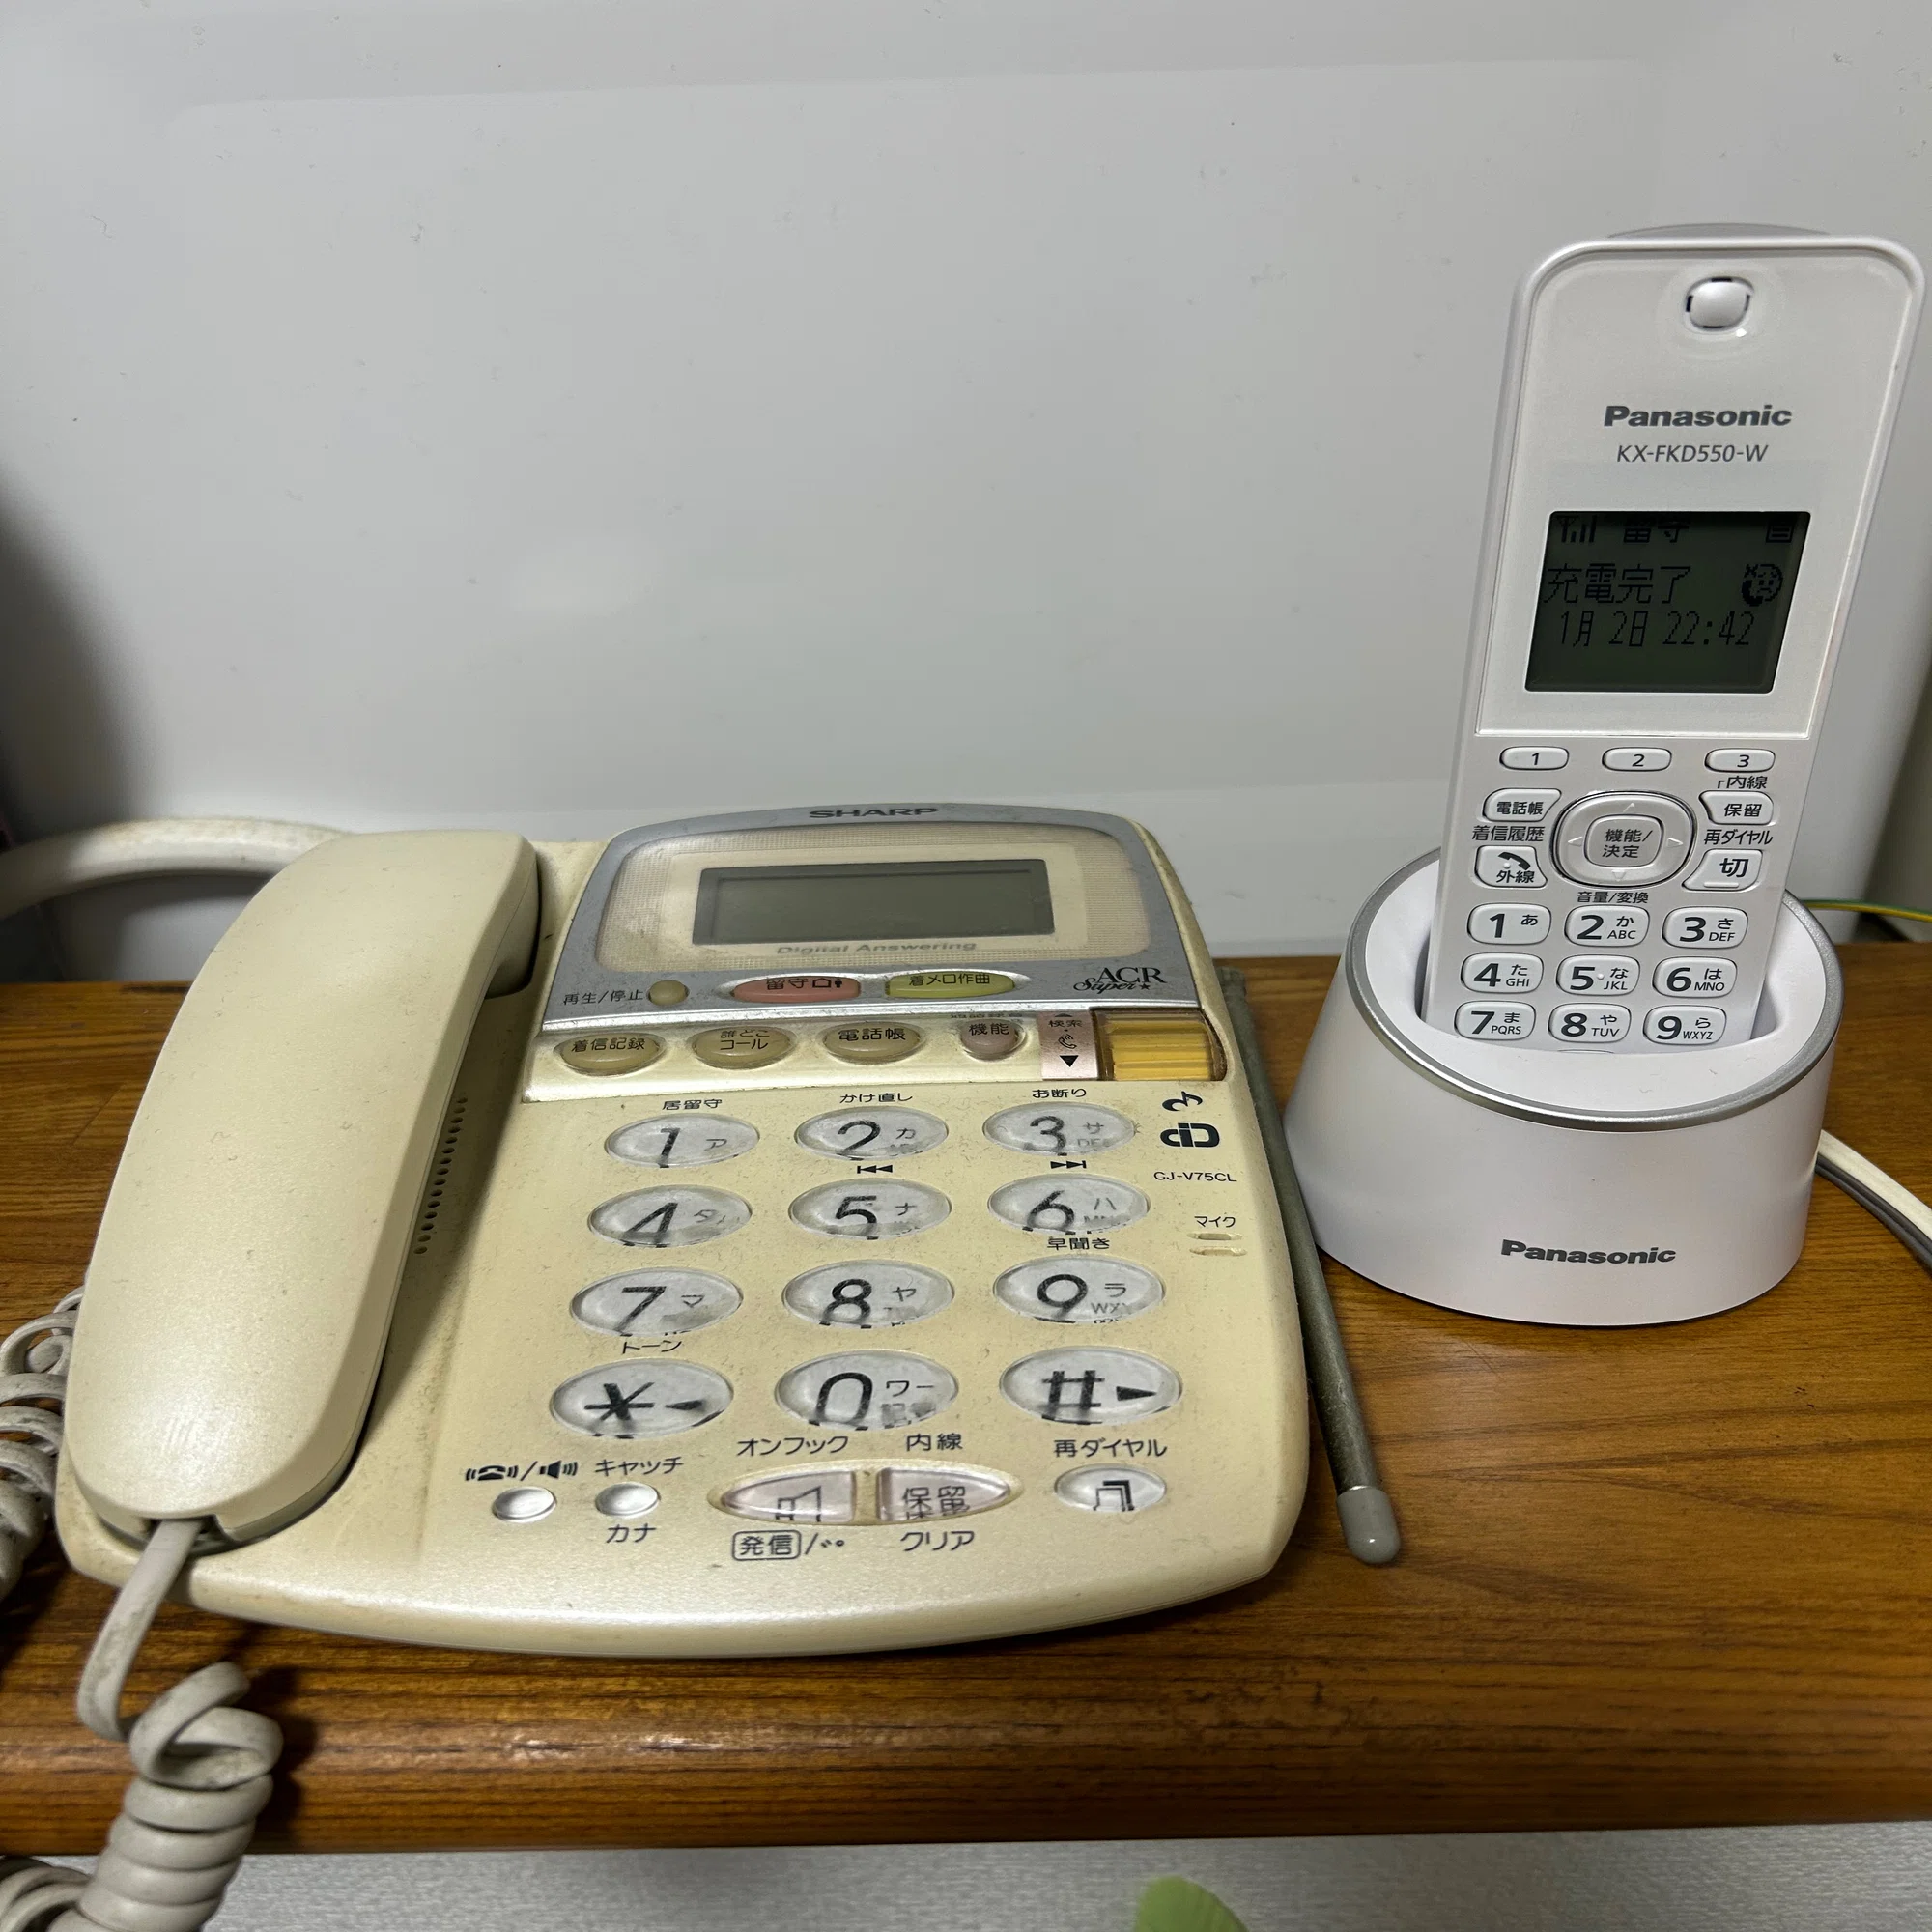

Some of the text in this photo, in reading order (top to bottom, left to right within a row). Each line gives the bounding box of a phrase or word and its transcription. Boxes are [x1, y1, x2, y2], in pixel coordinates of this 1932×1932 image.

[1604, 404, 1792, 427] Panasonic
[1616, 444, 1769, 463] KX-FKD550-W
[1544, 563, 1690, 604] 充電完了
[1662, 611, 1755, 646] 22:42
[1531, 753, 1541, 766] 1
[1632, 753, 1645, 768] 2
[1736, 754, 1750, 768] 3
[810, 808, 939, 818] SHARP
[1496, 802, 1544, 815] 電話帳
[1723, 803, 1762, 818] 保留
[1471, 825, 1546, 842] 着信履歴
[1703, 829, 1774, 846] 再ダイヤル
[1602, 844, 1640, 859] 決定
[1719, 858, 1748, 878] 切
[1495, 870, 1535, 884] 外線
[1577, 891, 1649, 904] 音量/変換
[1489, 913, 1539, 938] 1 あ
[1577, 914, 1634, 941] 2 か
[1679, 916, 1734, 943] 3 さ
[1606, 929, 1636, 940] ABC
[1708, 931, 1735, 942] DEF
[777, 941, 978, 956] Digital Answering
[908, 973, 991, 986] 着メロ作曲
[1097, 966, 1168, 983] ACR
[1472, 962, 1528, 987] 4 た
[1505, 977, 1530, 987] GHI
[1569, 965, 1629, 991] 5 な
[1665, 966, 1722, 992] 6 は
[766, 977, 810, 991] 留守
[1073, 978, 1136, 995] Super
[1603, 980, 1628, 991] JKL
[1693, 980, 1725, 992] MNO
[562, 989, 644, 1005] 再生/停止
[968, 1022, 1009, 1036] 機能
[1470, 1010, 1520, 1035] 7 ま
[1491, 1024, 1522, 1036] PQRS
[1560, 1011, 1617, 1037] 8 や
[1655, 1014, 1712, 1040] 9 ら
[720, 1028, 770, 1038] 誰どこ
[838, 1028, 907, 1041] 電話帳
[1591, 1026, 1620, 1037] TUV
[1682, 1029, 1714, 1040] WXYZ
[571, 1037, 646, 1053] 着信記録
[719, 1038, 769, 1051] コール
[839, 1093, 913, 1104] かけ直し
[1032, 1088, 1087, 1099] お断り
[662, 1098, 723, 1111] 居留守
[837, 1120, 881, 1161] 2
[895, 1128, 917, 1140] カ
[1023, 1115, 1067, 1156] 3
[657, 1126, 727, 1168] 1 ア
[1153, 1171, 1237, 1183] CJ-V75CL
[835, 1195, 878, 1240] 5
[895, 1202, 918, 1216] ナ
[1024, 1189, 1075, 1235] 6
[1094, 1197, 1117, 1211] ハ
[621, 1202, 679, 1248] 4
[1193, 1214, 1236, 1228] マイク
[1047, 1237, 1111, 1250] 早聞き
[1500, 1239, 1677, 1264] Panasonic
[819, 1278, 872, 1329] 8
[892, 1286, 917, 1302] ヤ
[1037, 1273, 1127, 1323] 9 ラ
[612, 1286, 668, 1336] 7
[681, 1294, 706, 1308] マ
[621, 1340, 683, 1354] トーン
[809, 1371, 873, 1431] 0
[737, 1435, 849, 1457] オンフック
[906, 1433, 963, 1452] 内線
[1054, 1438, 1167, 1459] 再ダイヤル
[595, 1457, 684, 1476] キャッチ
[606, 1523, 657, 1544] カナ
[900, 1531, 976, 1551] クリア
